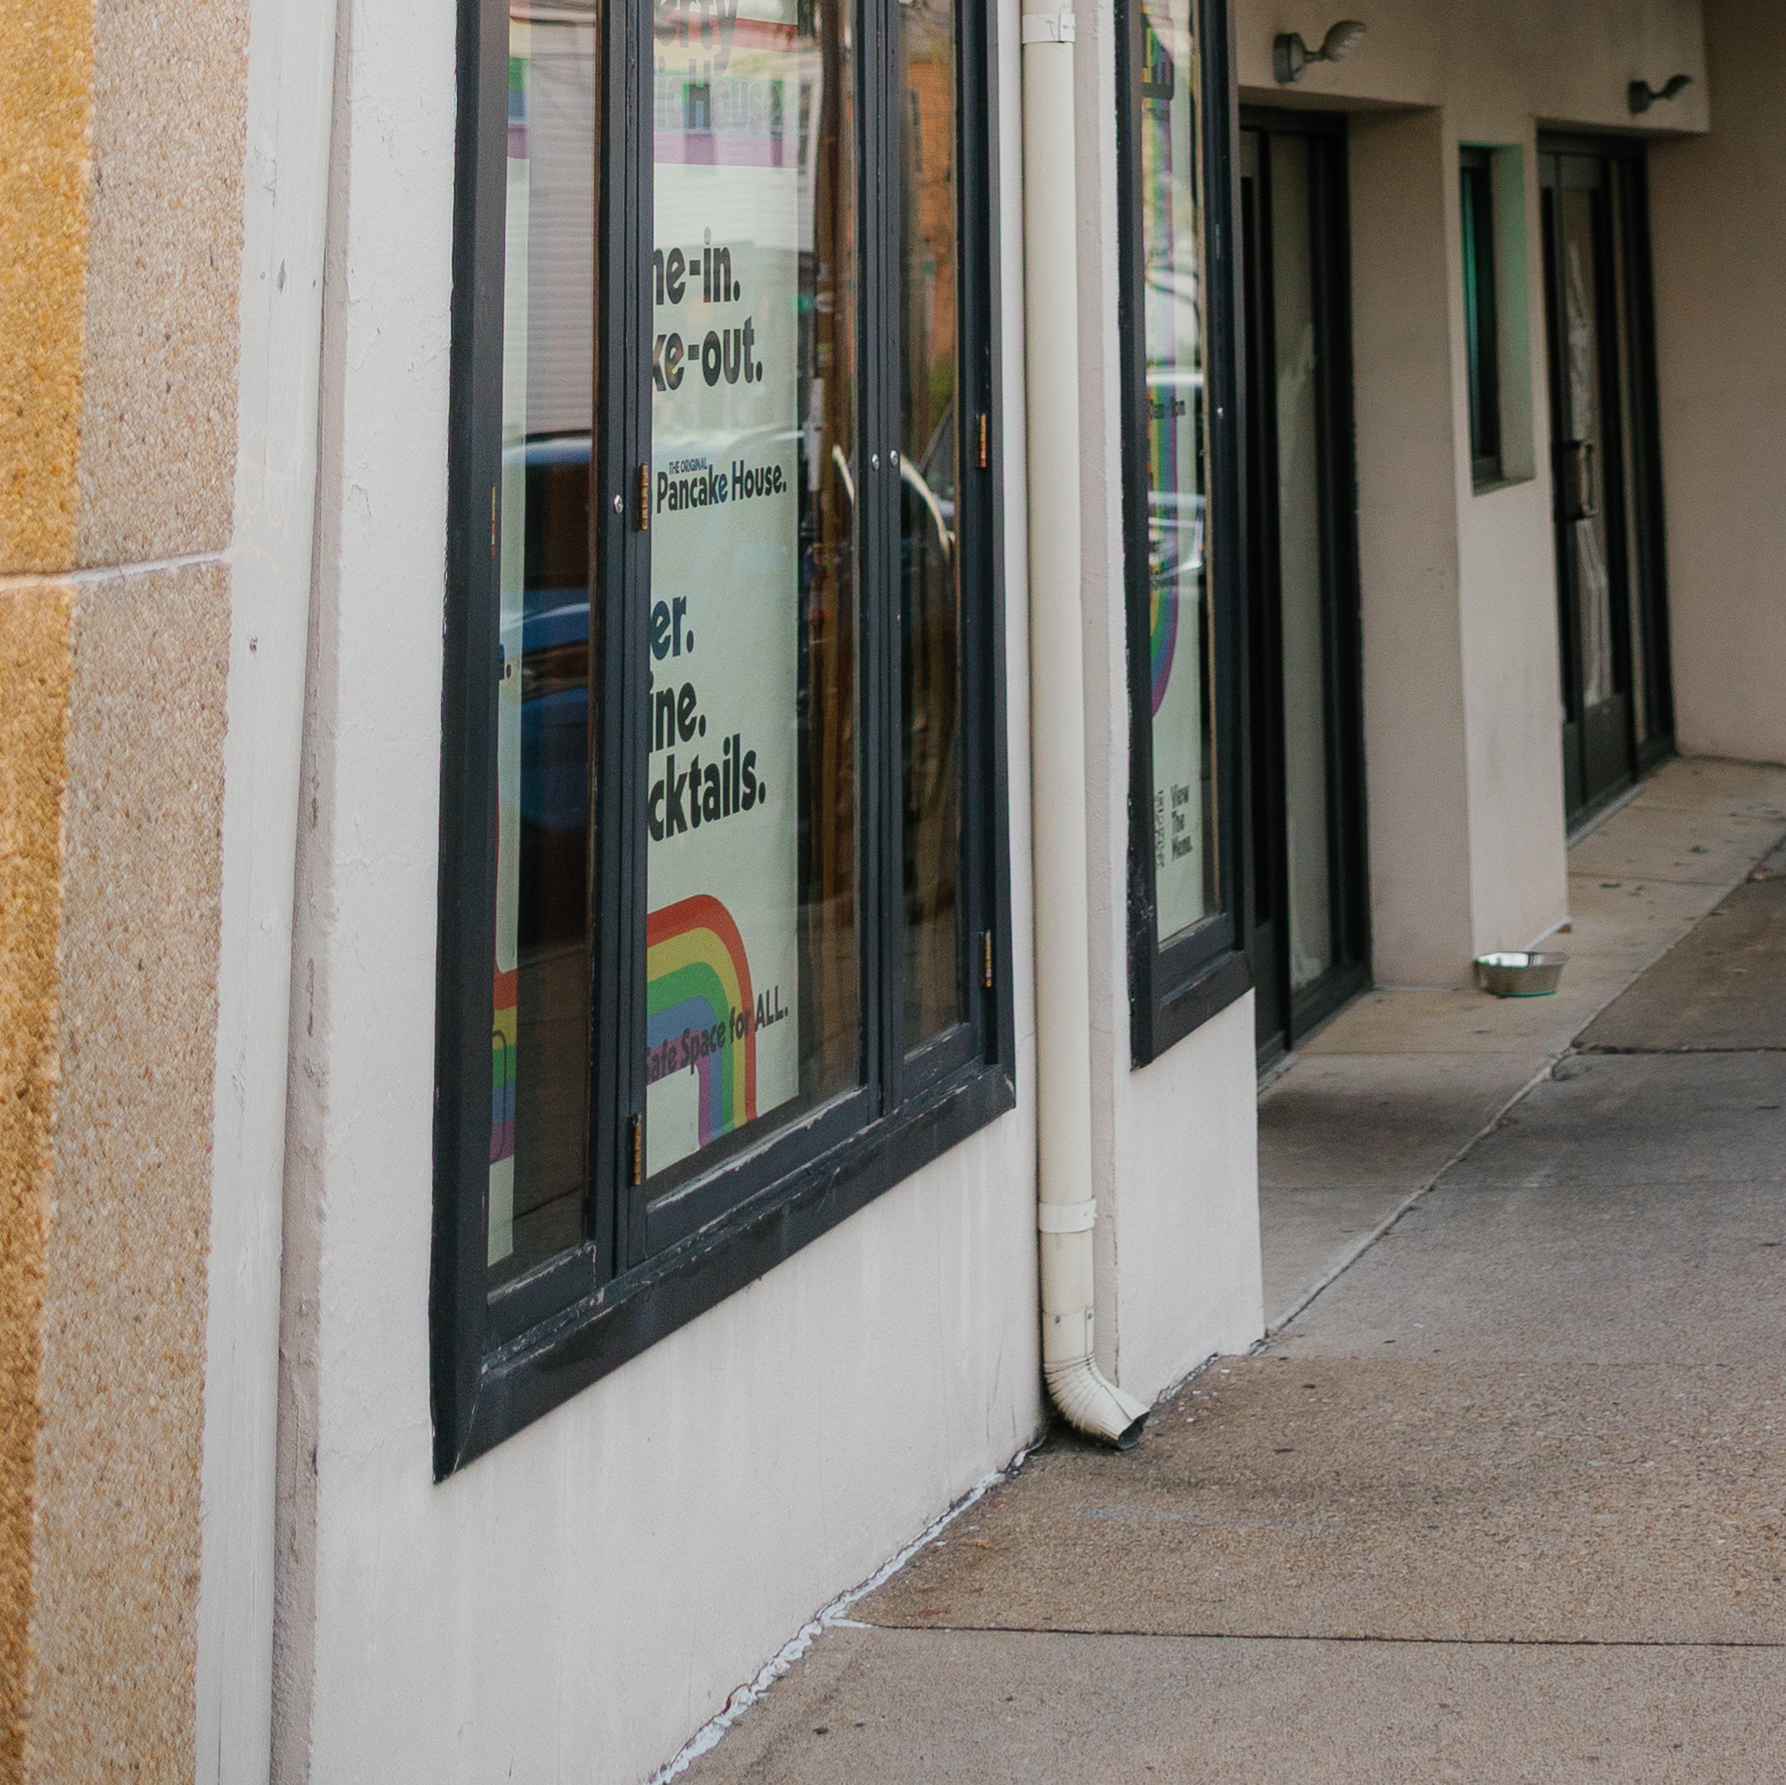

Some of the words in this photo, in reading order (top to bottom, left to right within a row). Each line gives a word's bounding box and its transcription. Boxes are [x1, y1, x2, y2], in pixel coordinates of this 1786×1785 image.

[656, 463, 728, 515] Pancake
[731, 459, 787, 502] House.
[668, 460, 680, 476] THE
[680, 456, 708, 474] ORIGINAL
[681, 1021, 727, 1076] Space
[729, 1006, 752, 1044] for
[754, 985, 789, 1033] ALL.
